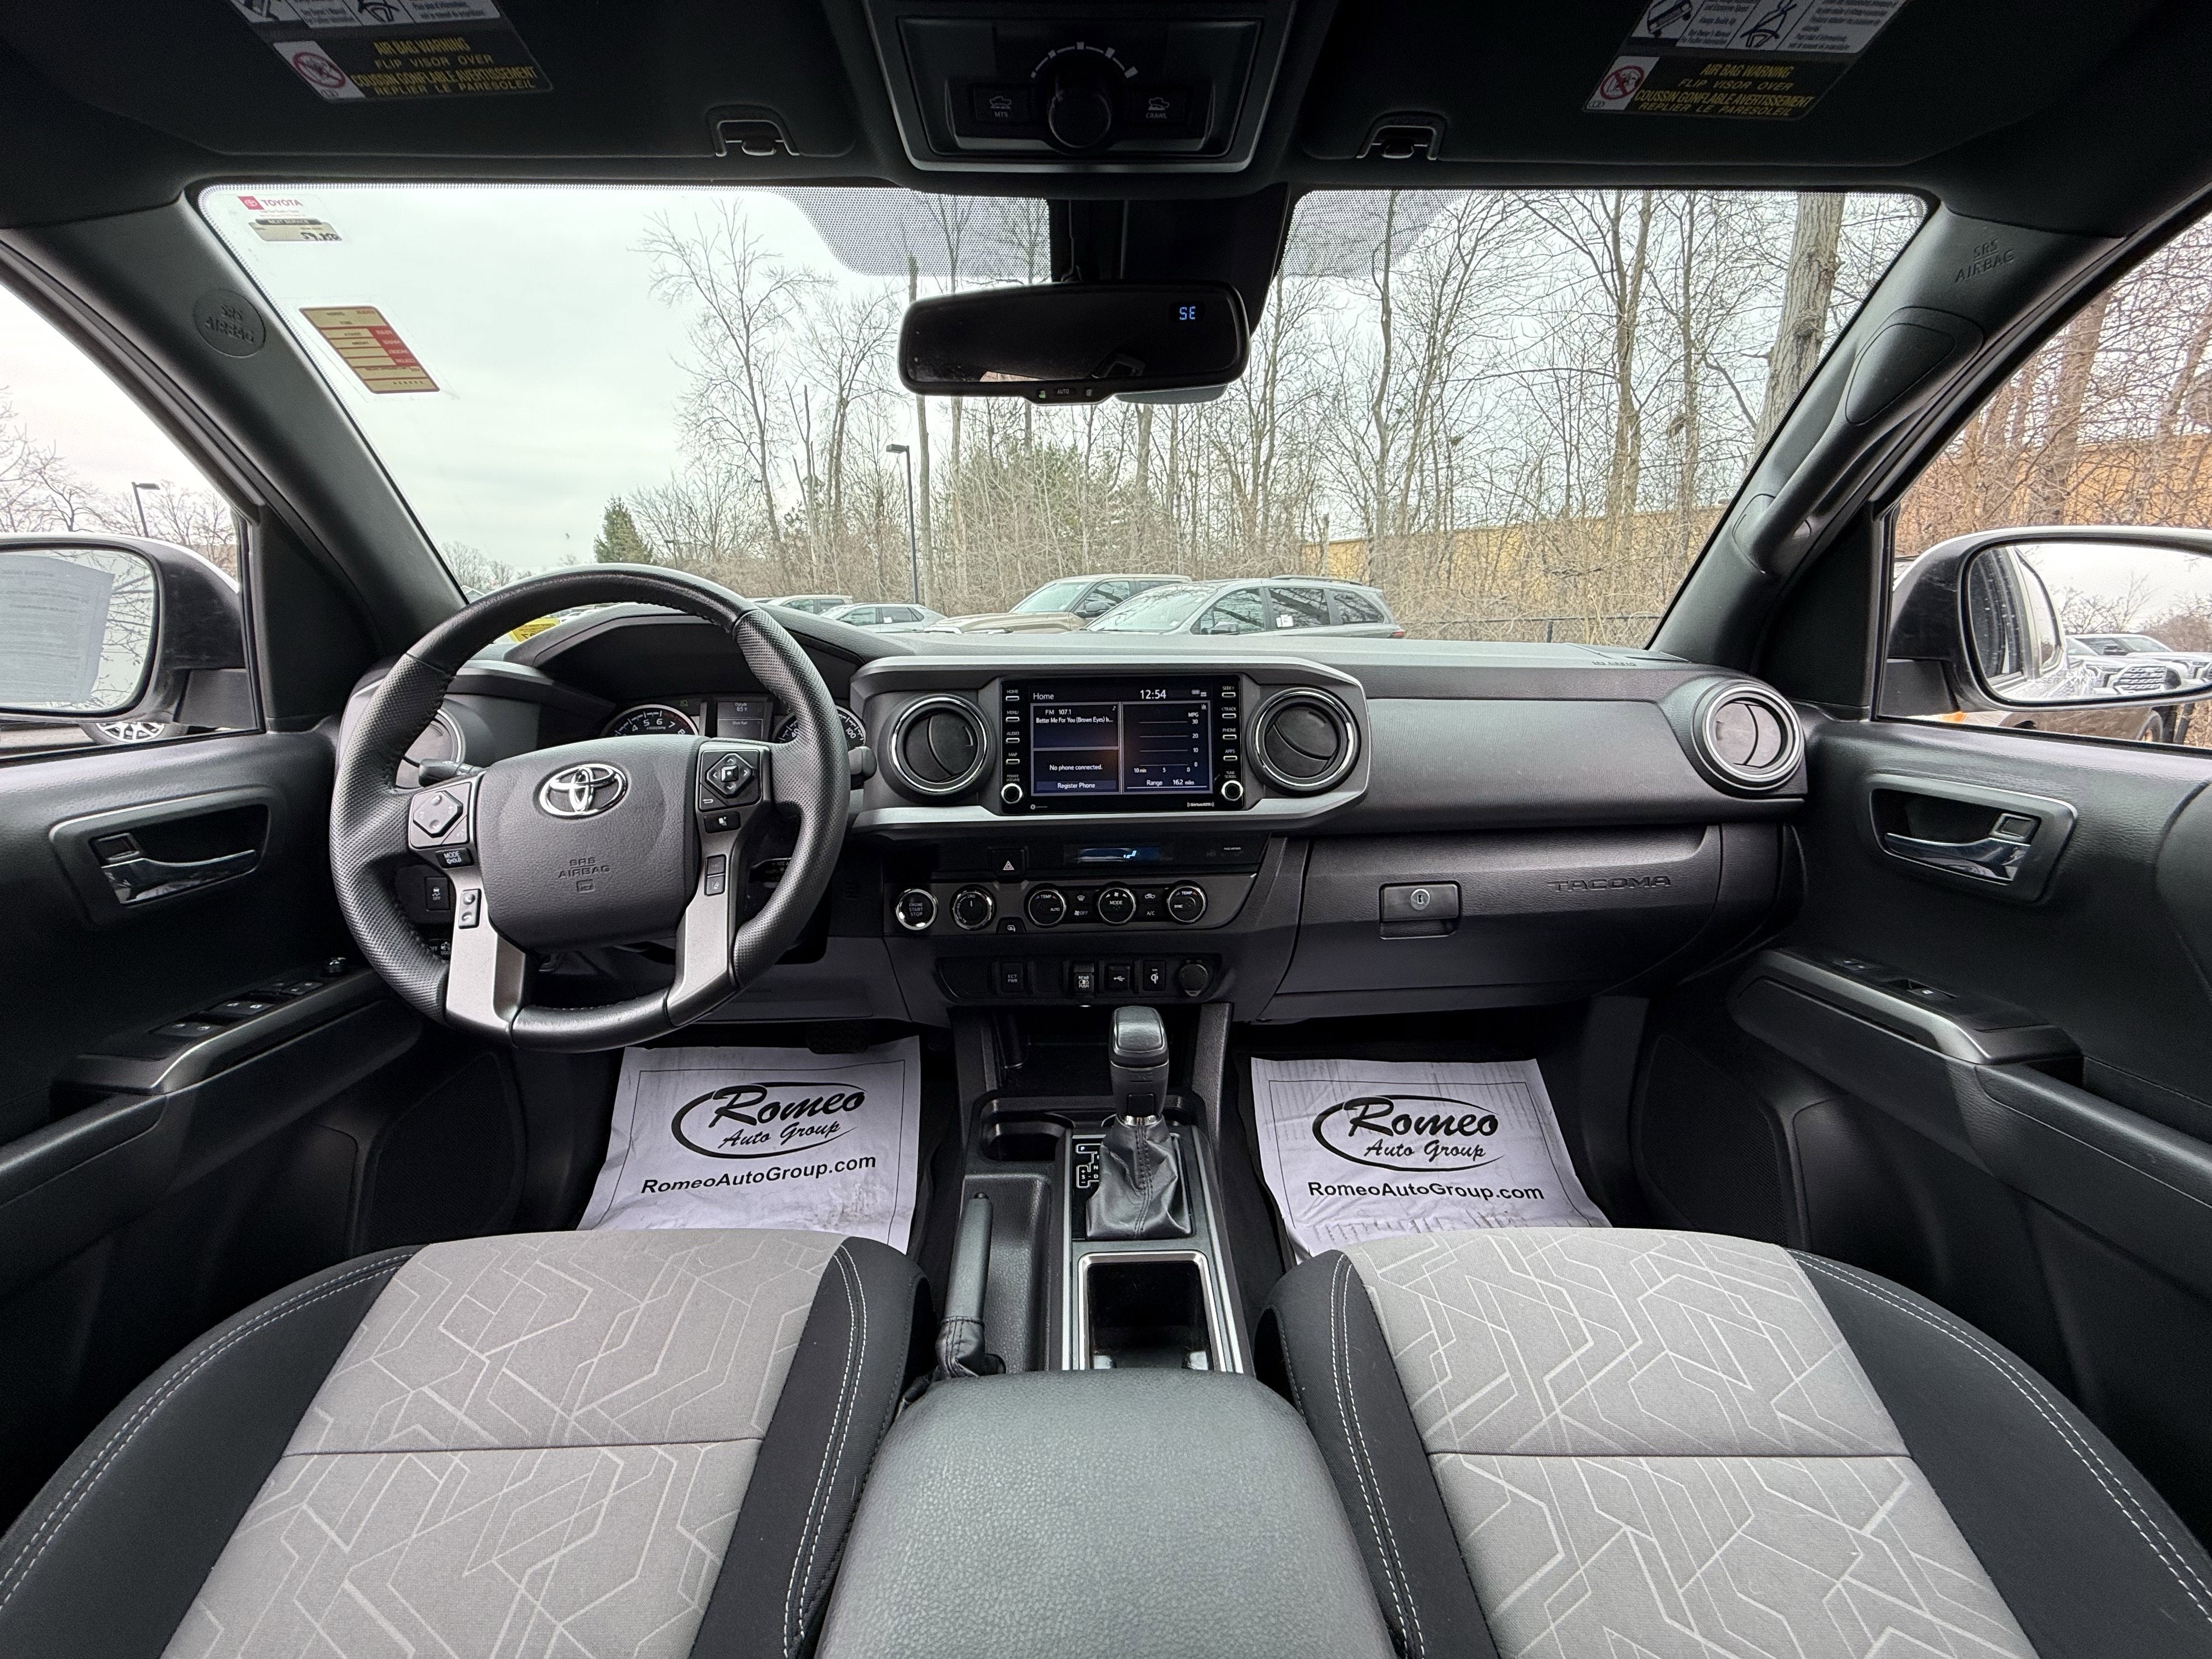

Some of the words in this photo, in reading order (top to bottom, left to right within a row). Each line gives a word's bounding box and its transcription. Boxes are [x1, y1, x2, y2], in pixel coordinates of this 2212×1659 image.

[374, 41, 397, 55] AIR
[398, 39, 420, 54] BAG
[415, 37, 471, 53] WARNING
[374, 58, 402, 70] FLIP
[410, 55, 450, 68] VISOR
[458, 54, 494, 66] OVER
[455, 66, 538, 82] AVERTISSEMENT
[1700, 64, 1720, 76] AIR
[1719, 64, 1743, 77] BAG
[1741, 65, 1794, 78] WARNING
[374, 84, 428, 97] REPLIER
[436, 83, 450, 93] LE
[1678, 78, 1708, 88] FLIP
[1713, 80, 1753, 89] VISOR
[1757, 82, 1794, 92] OVER
[1634, 89, 1679, 103] COUSSIN
[1731, 94, 1815, 108] AVERTISSEMENT
[1638, 102, 1691, 112] REPLIER
[1696, 104, 1714, 113] LE
[1974, 238, 2000, 258] SRS
[1955, 249, 2015, 283] AIRBAG
[1179, 306, 1196, 320] SE
[205, 317, 254, 343] AIRBAG
[1140, 690, 1166, 699] 12:54
[845, 727, 856, 739] 100
[569, 857, 596, 866] SRS
[558, 865, 610, 878] AIRBAG
[1547, 876, 1671, 892] TACOMA
[708, 1084, 866, 1128] Romeo
[1342, 1096, 1498, 1137] Romeo
[717, 1128, 771, 1149] Auto
[780, 1120, 840, 1146] Group
[1364, 1138, 1414, 1158] Auto
[1424, 1139, 1486, 1158] Group
[640, 1156, 876, 1194] RomeoAutoGroup.com
[1307, 1181, 1545, 1201] RomeoAutoGroup.com
